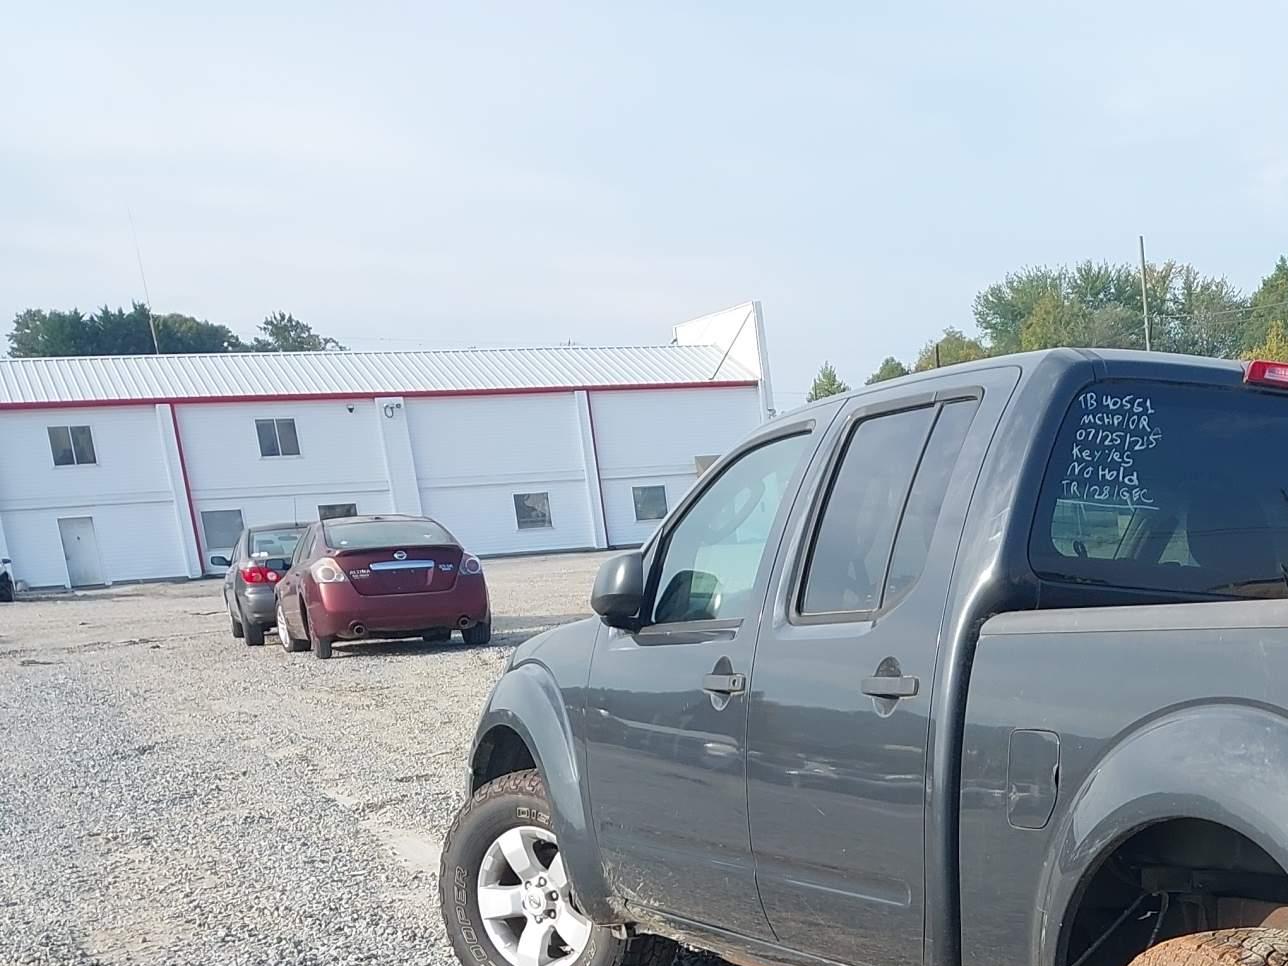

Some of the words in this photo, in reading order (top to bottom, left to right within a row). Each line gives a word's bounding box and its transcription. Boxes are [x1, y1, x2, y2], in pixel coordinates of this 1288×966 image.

[1079, 392, 1097, 410] TB
[1067, 462, 1094, 478] No
[1098, 465, 1139, 486] Hold
